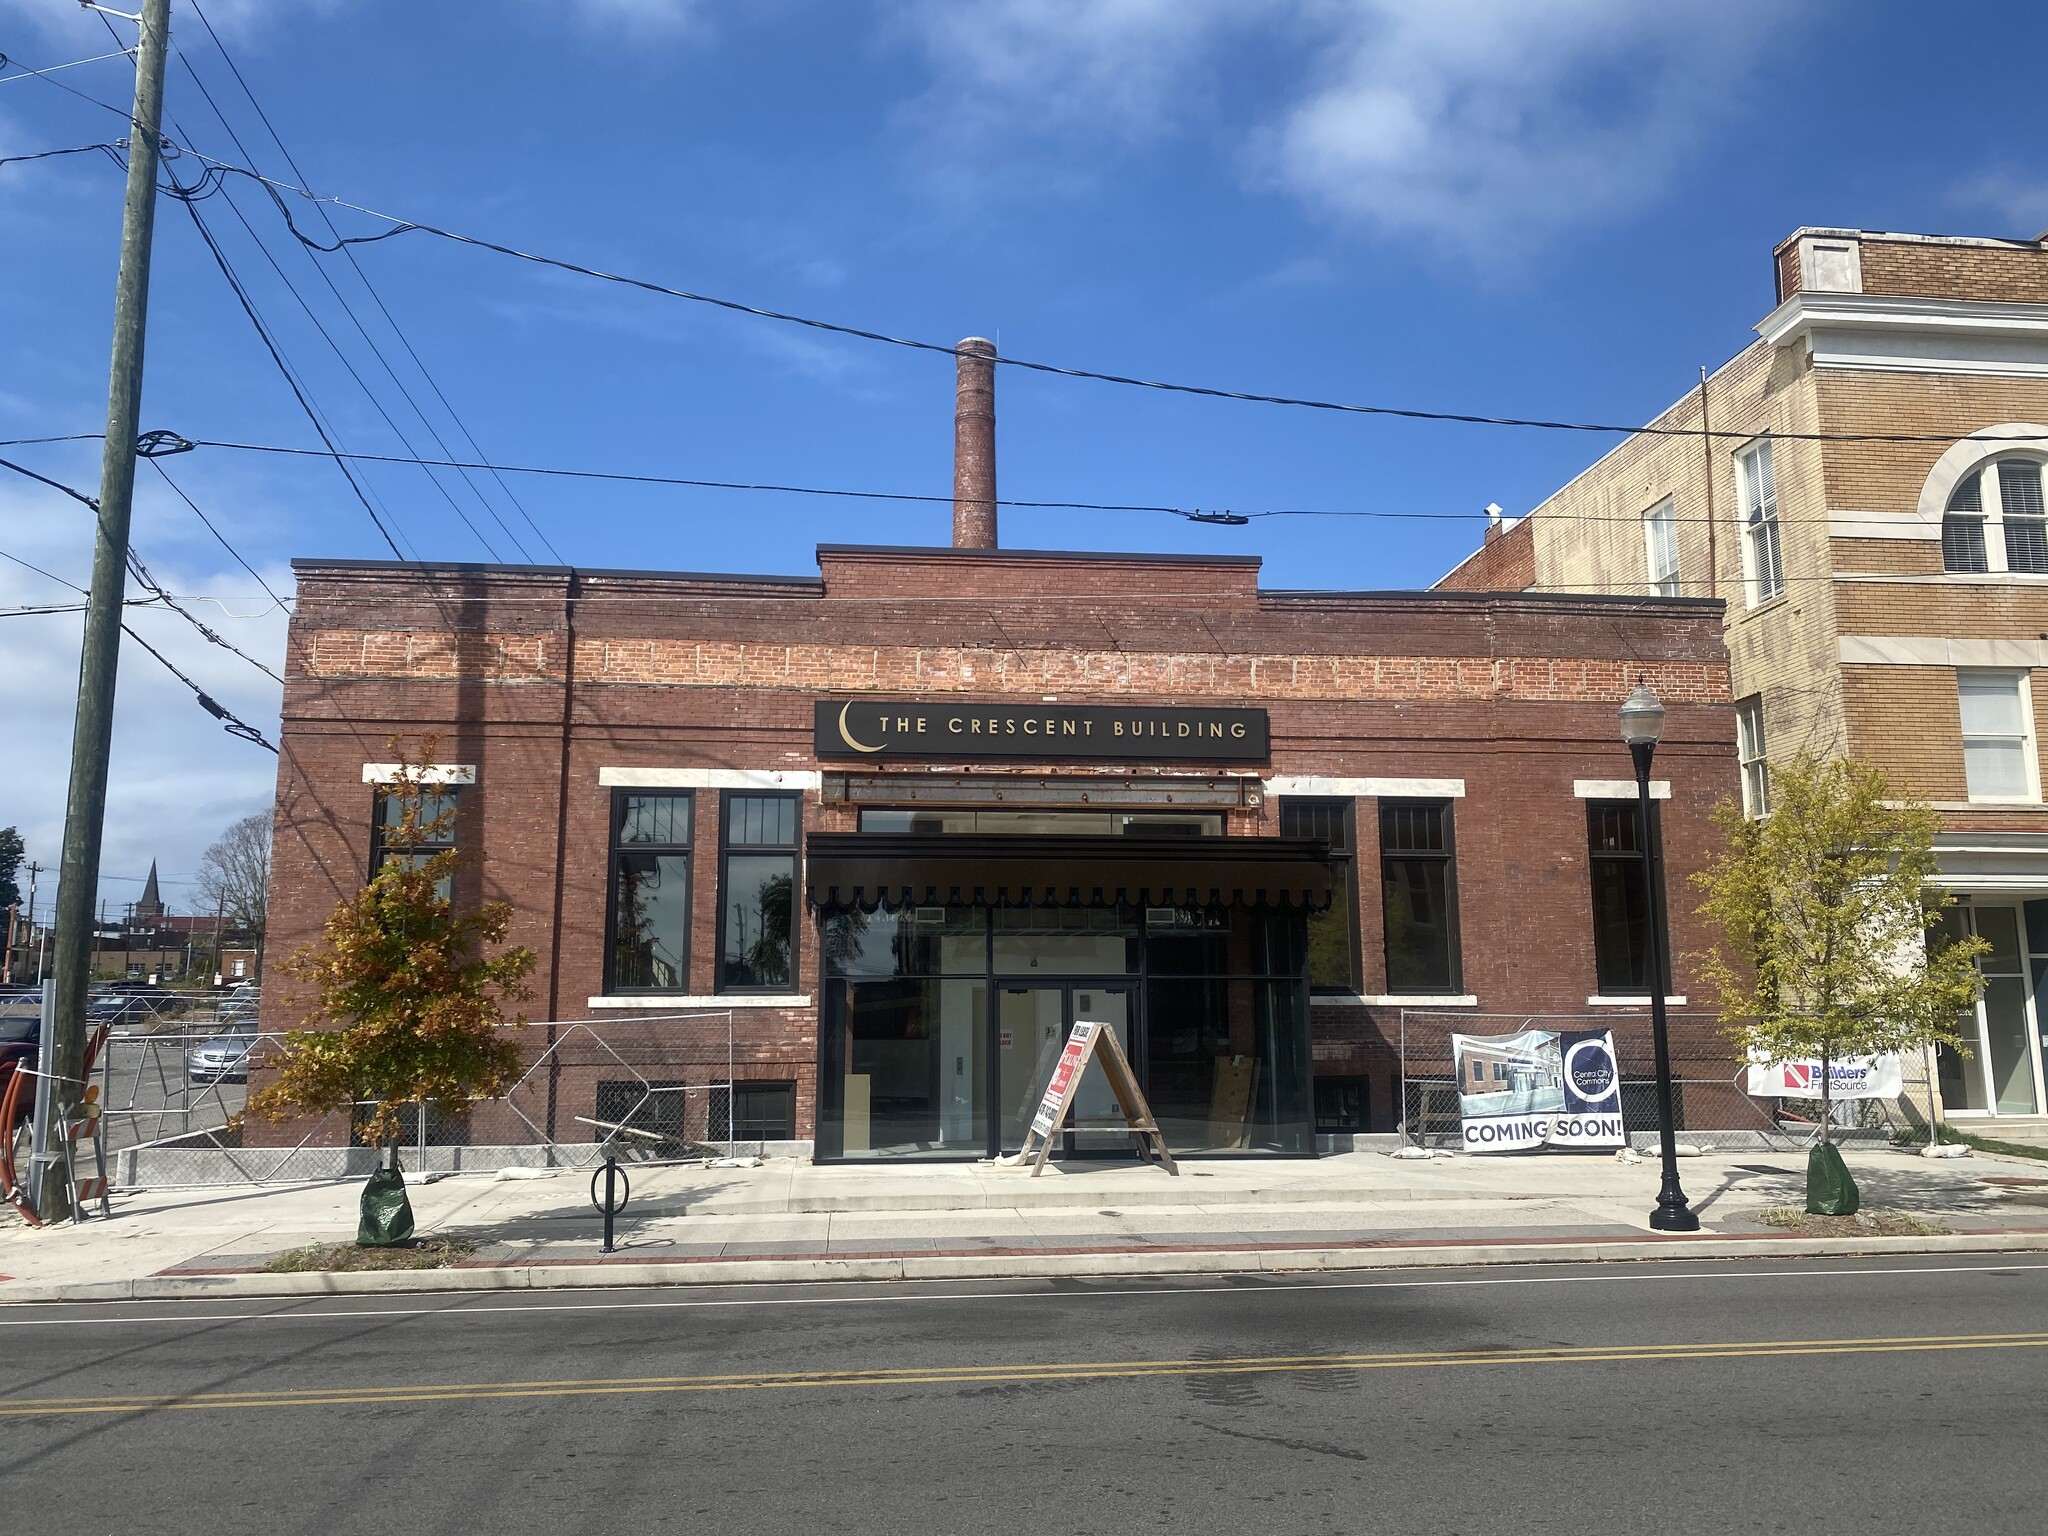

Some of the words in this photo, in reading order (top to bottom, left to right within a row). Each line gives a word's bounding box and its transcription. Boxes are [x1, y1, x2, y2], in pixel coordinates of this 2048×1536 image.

[880, 716, 926, 733] THE
[948, 717, 1093, 736] CRESCENT
[1114, 720, 1247, 738] BUILDING
[1573, 1070, 1596, 1078] Central
[1596, 1069, 1612, 1078] City
[1811, 1065, 1867, 1080] Bilders
[1465, 1120, 1548, 1143] COMING
[1555, 1119, 1622, 1137] SOON!
